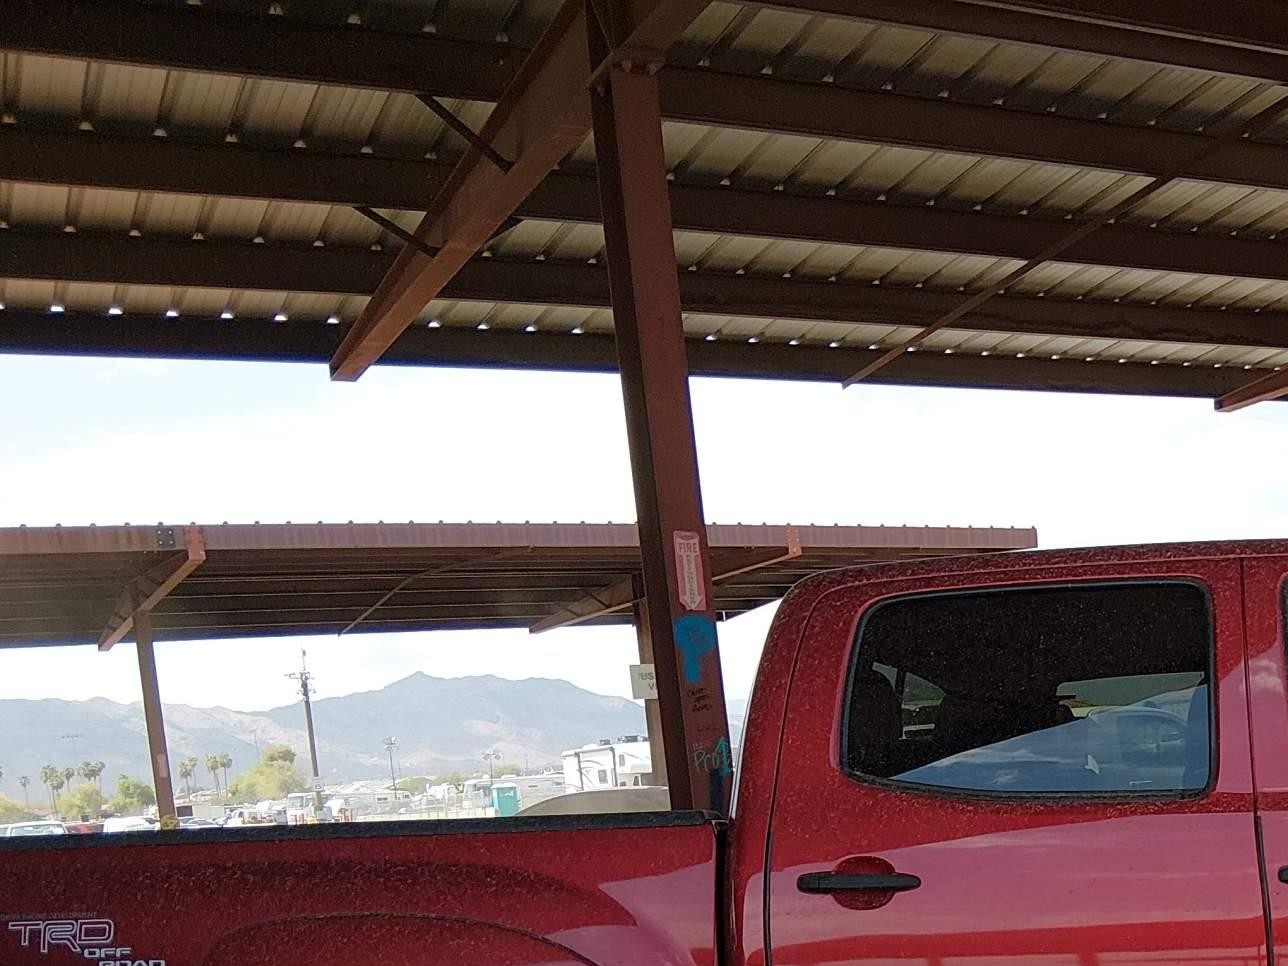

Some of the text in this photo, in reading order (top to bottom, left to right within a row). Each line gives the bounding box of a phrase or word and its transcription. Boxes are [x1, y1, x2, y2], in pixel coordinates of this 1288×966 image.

[678, 542, 697, 553] FIRE
[640, 671, 655, 681] US
[8, 919, 115, 953] TRD
[83, 947, 132, 958] OFF
